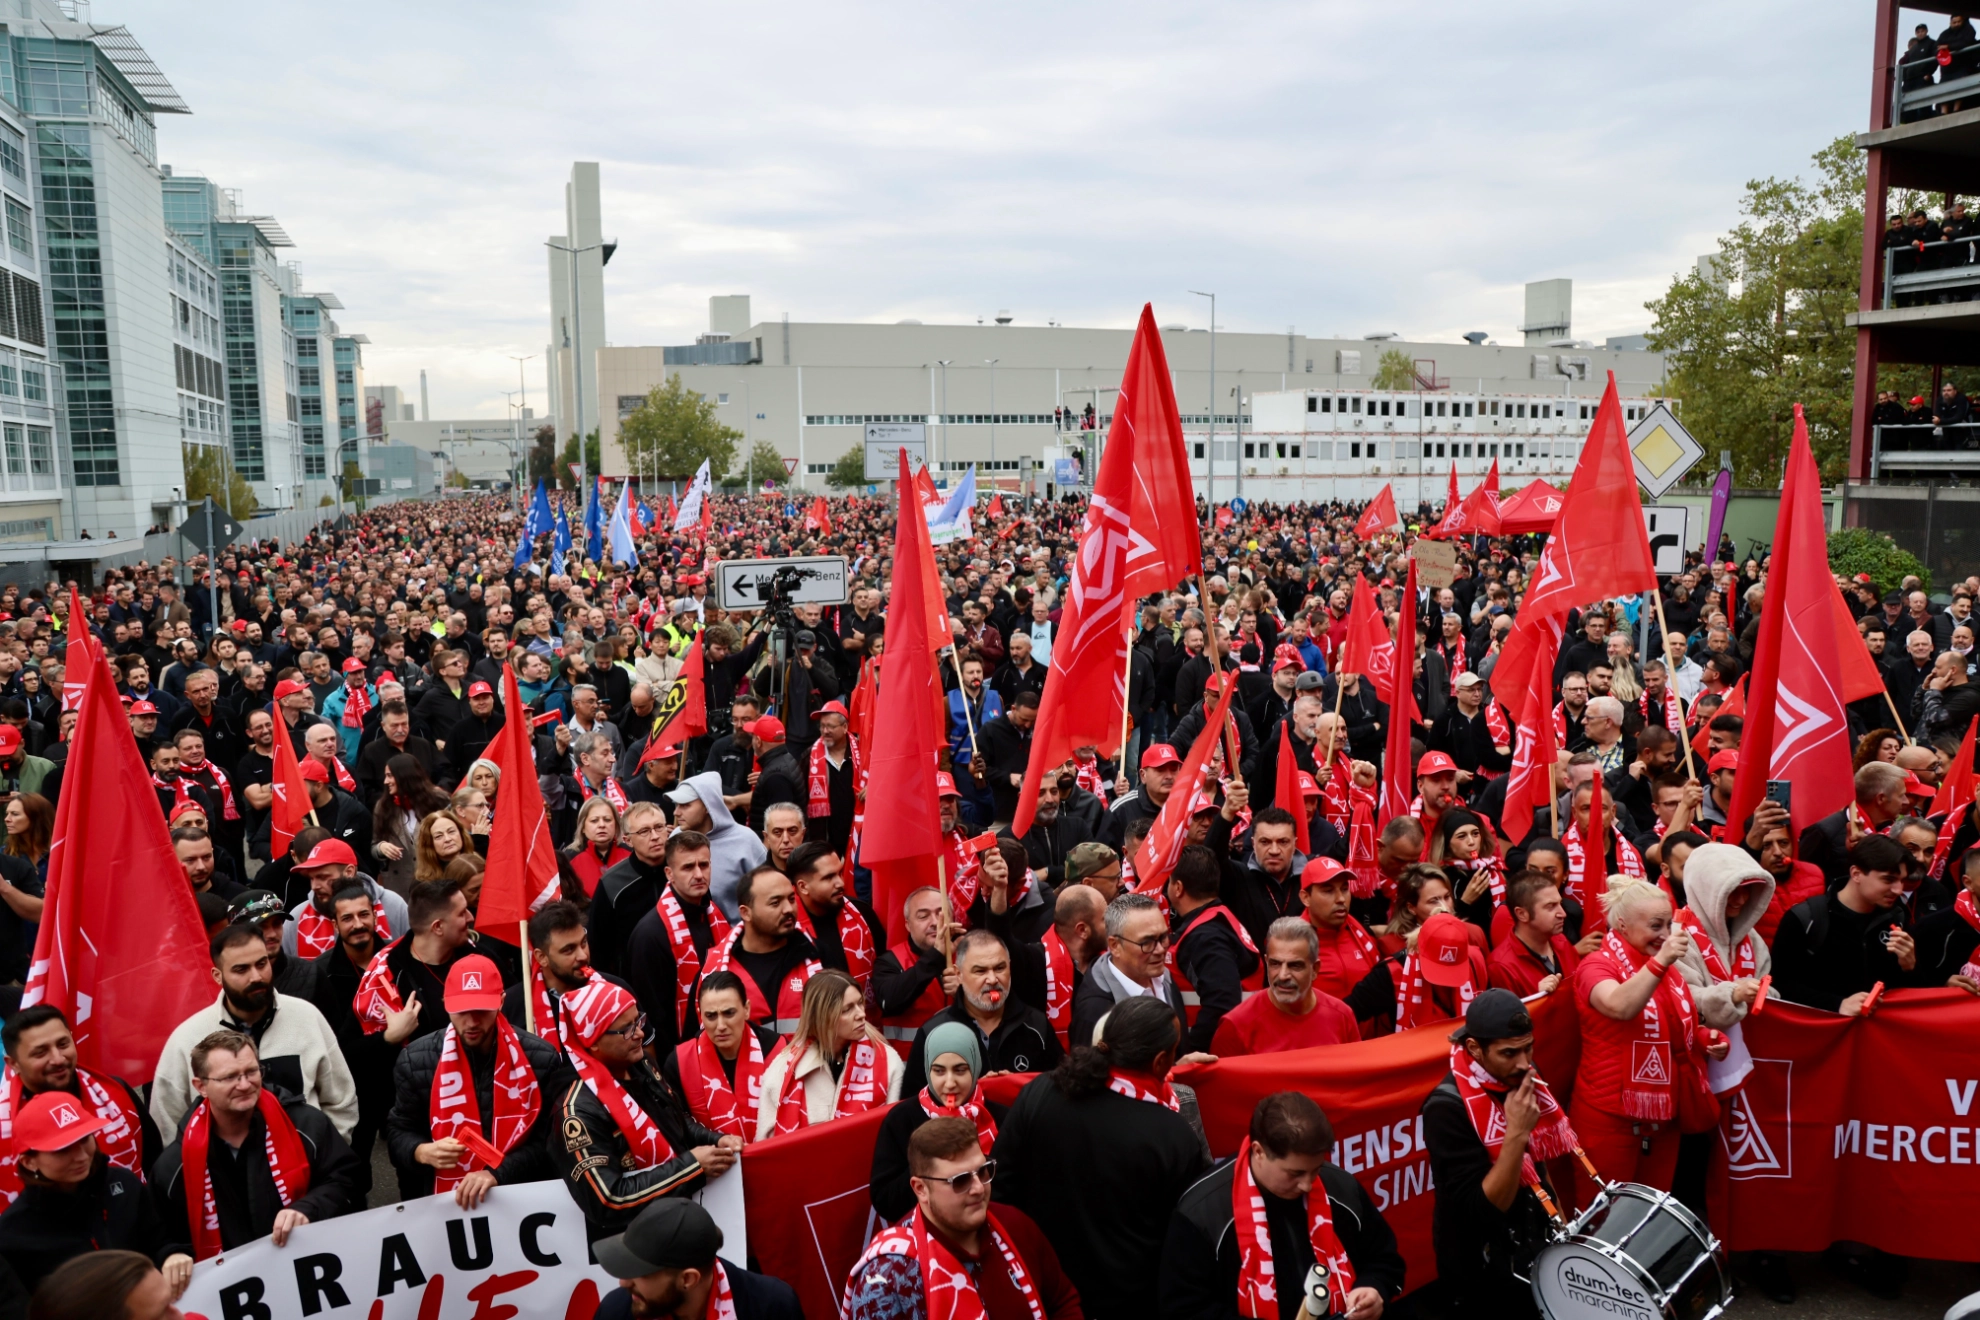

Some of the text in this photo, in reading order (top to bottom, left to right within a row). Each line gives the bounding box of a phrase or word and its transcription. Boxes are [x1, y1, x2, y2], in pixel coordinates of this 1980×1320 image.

[1834, 1119, 1980, 1165] MERCE
[219, 1211, 600, 1320] BRAUC
[1564, 1266, 1646, 1304] drum-tec
